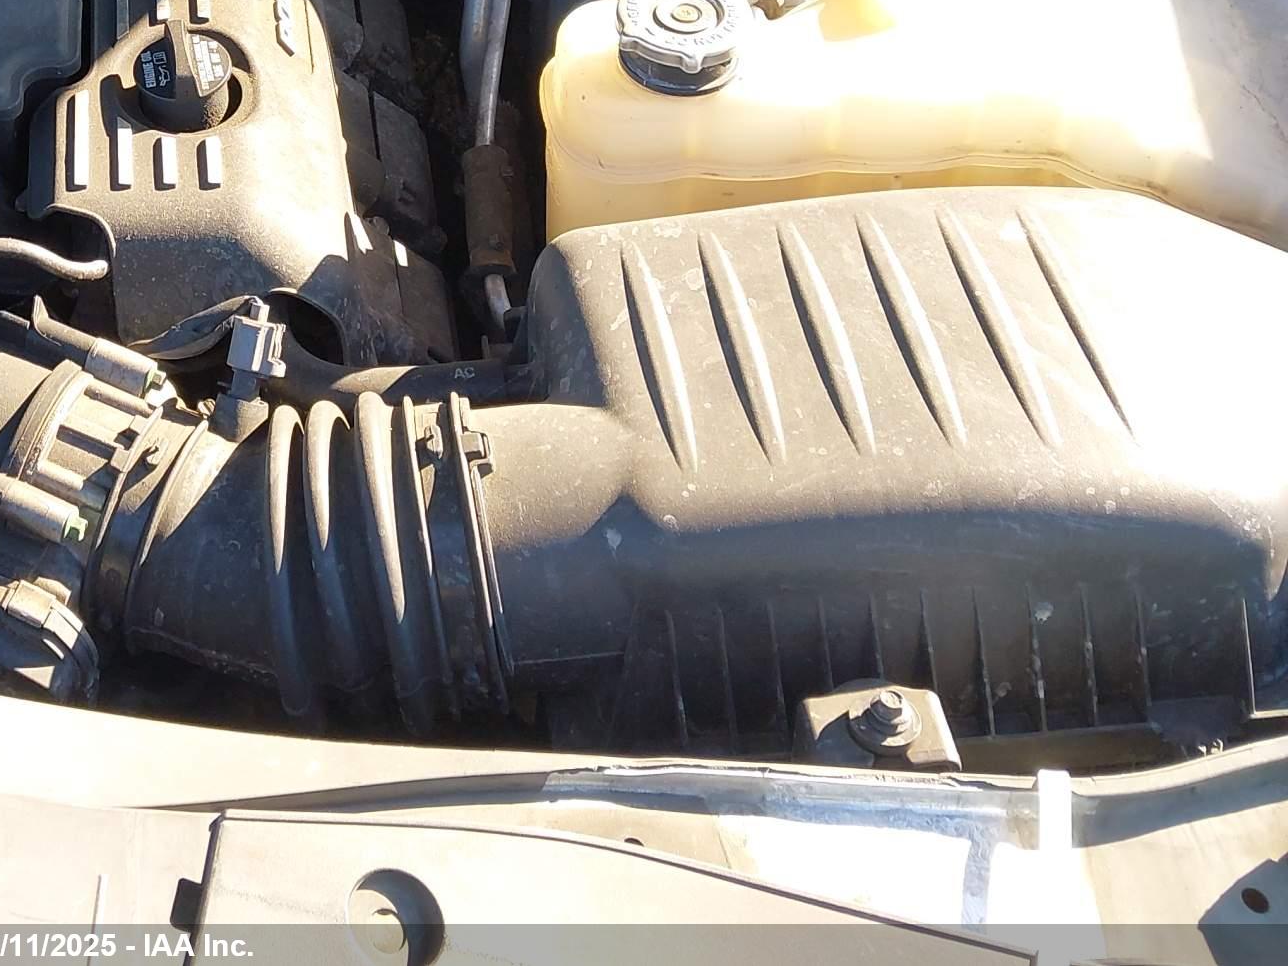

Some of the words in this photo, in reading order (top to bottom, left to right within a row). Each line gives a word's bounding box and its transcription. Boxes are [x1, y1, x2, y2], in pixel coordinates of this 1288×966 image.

[140, 50, 153, 63] OIL
[142, 62, 157, 89] ENGINE
[454, 367, 475, 379] AC
